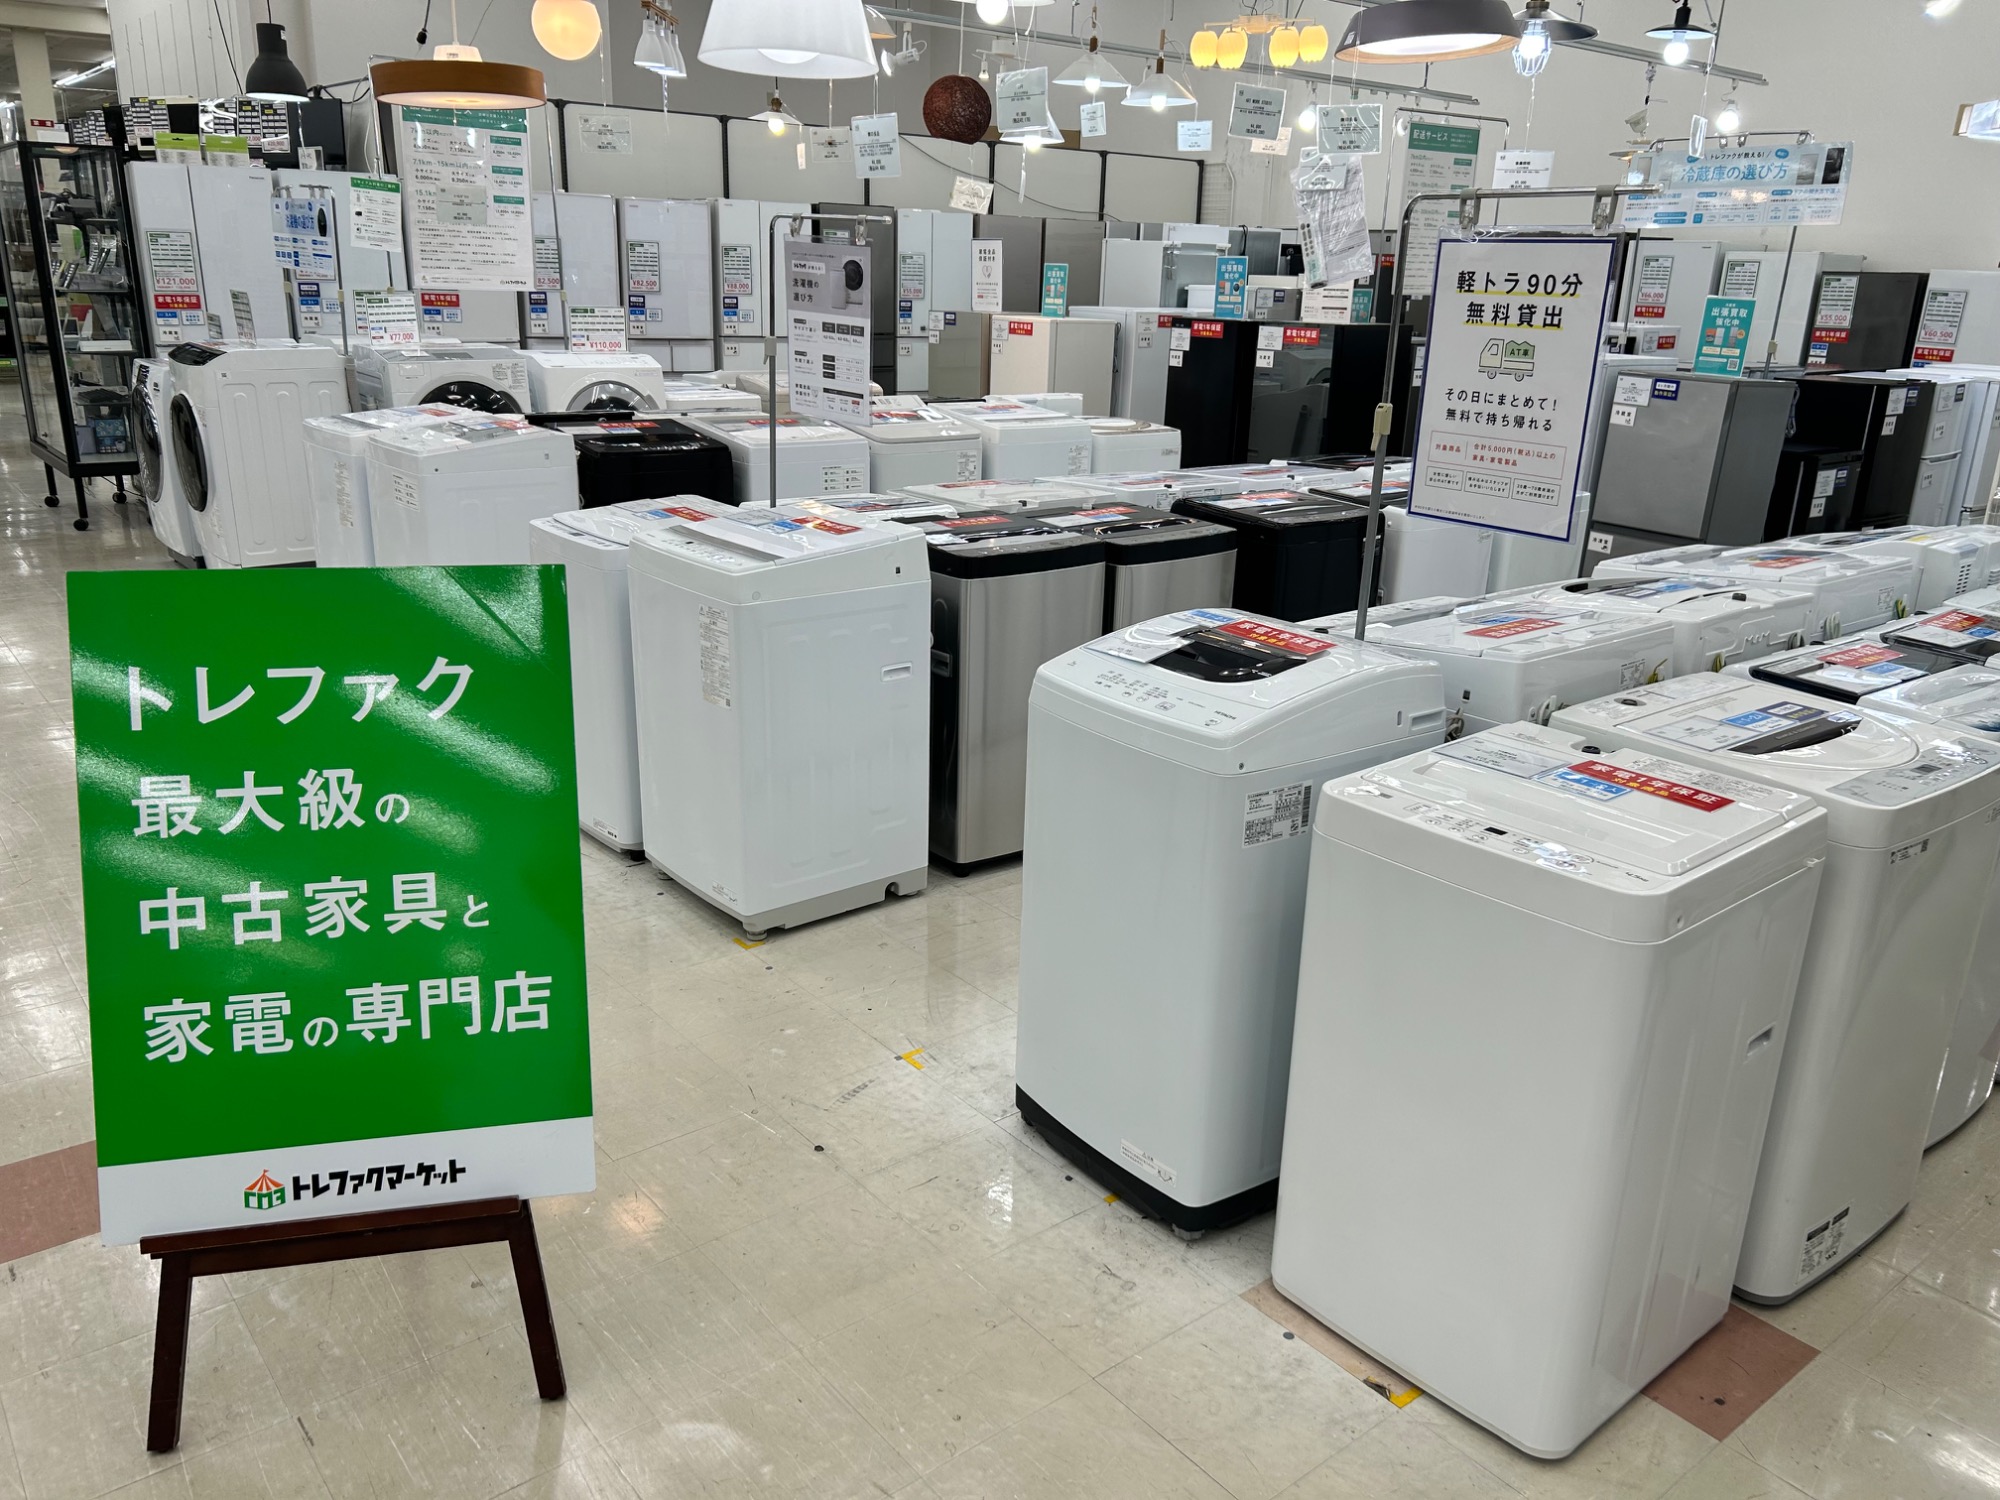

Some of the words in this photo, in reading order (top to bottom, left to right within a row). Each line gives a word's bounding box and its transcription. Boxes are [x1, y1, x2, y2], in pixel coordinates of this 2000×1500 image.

[1413, 129, 1449, 141] 配送サービス
[1680, 163, 1790, 184] 冷蔵庫の選び方
[1220, 264, 1243, 272] 出張買取
[156, 277, 195, 286] ¥121,000
[1224, 272, 1240, 280] 強化中
[632, 279, 657, 287] ¥82,500
[792, 278, 819, 288] 洗濯機の
[1456, 270, 1584, 297] 軽トラ90分
[793, 292, 813, 303] 選び方
[1465, 301, 1563, 328] 無料貸出
[1711, 307, 1748, 318] 出張買取
[1820, 313, 1847, 322] ¥55,000
[1193, 322, 1221, 331] 家電1年保証
[1715, 317, 1740, 326] 強化中
[389, 333, 415, 342] ¥77,000
[1286, 329, 1317, 338] 家電1年保証
[1815, 331, 1847, 339] 家電1年保証
[1923, 328, 1953, 339] ¥60,500
[590, 341, 621, 349] ¥110,000
[1509, 348, 1530, 357] AT車
[1917, 348, 1951, 357] 家電1年保証
[1445, 407, 1552, 432] 無料で持ち帰れる
[1615, 410, 1632, 418] 冷蔵室
[1435, 443, 1461, 453] 対象商品
[1239, 622, 1327, 649] 家電1年保証
[128, 656, 474, 731] トレファク
[1214, 709, 1237, 721] HITACHI
[1588, 763, 1720, 805] 家電1年保証
[1612, 777, 1669, 797] 対象商品
[131, 768, 410, 839] 最大級の
[139, 871, 490, 950] 中古家具と
[143, 971, 552, 1062] 家電の専門店
[292, 1159, 466, 1201] トレファクマーケット
